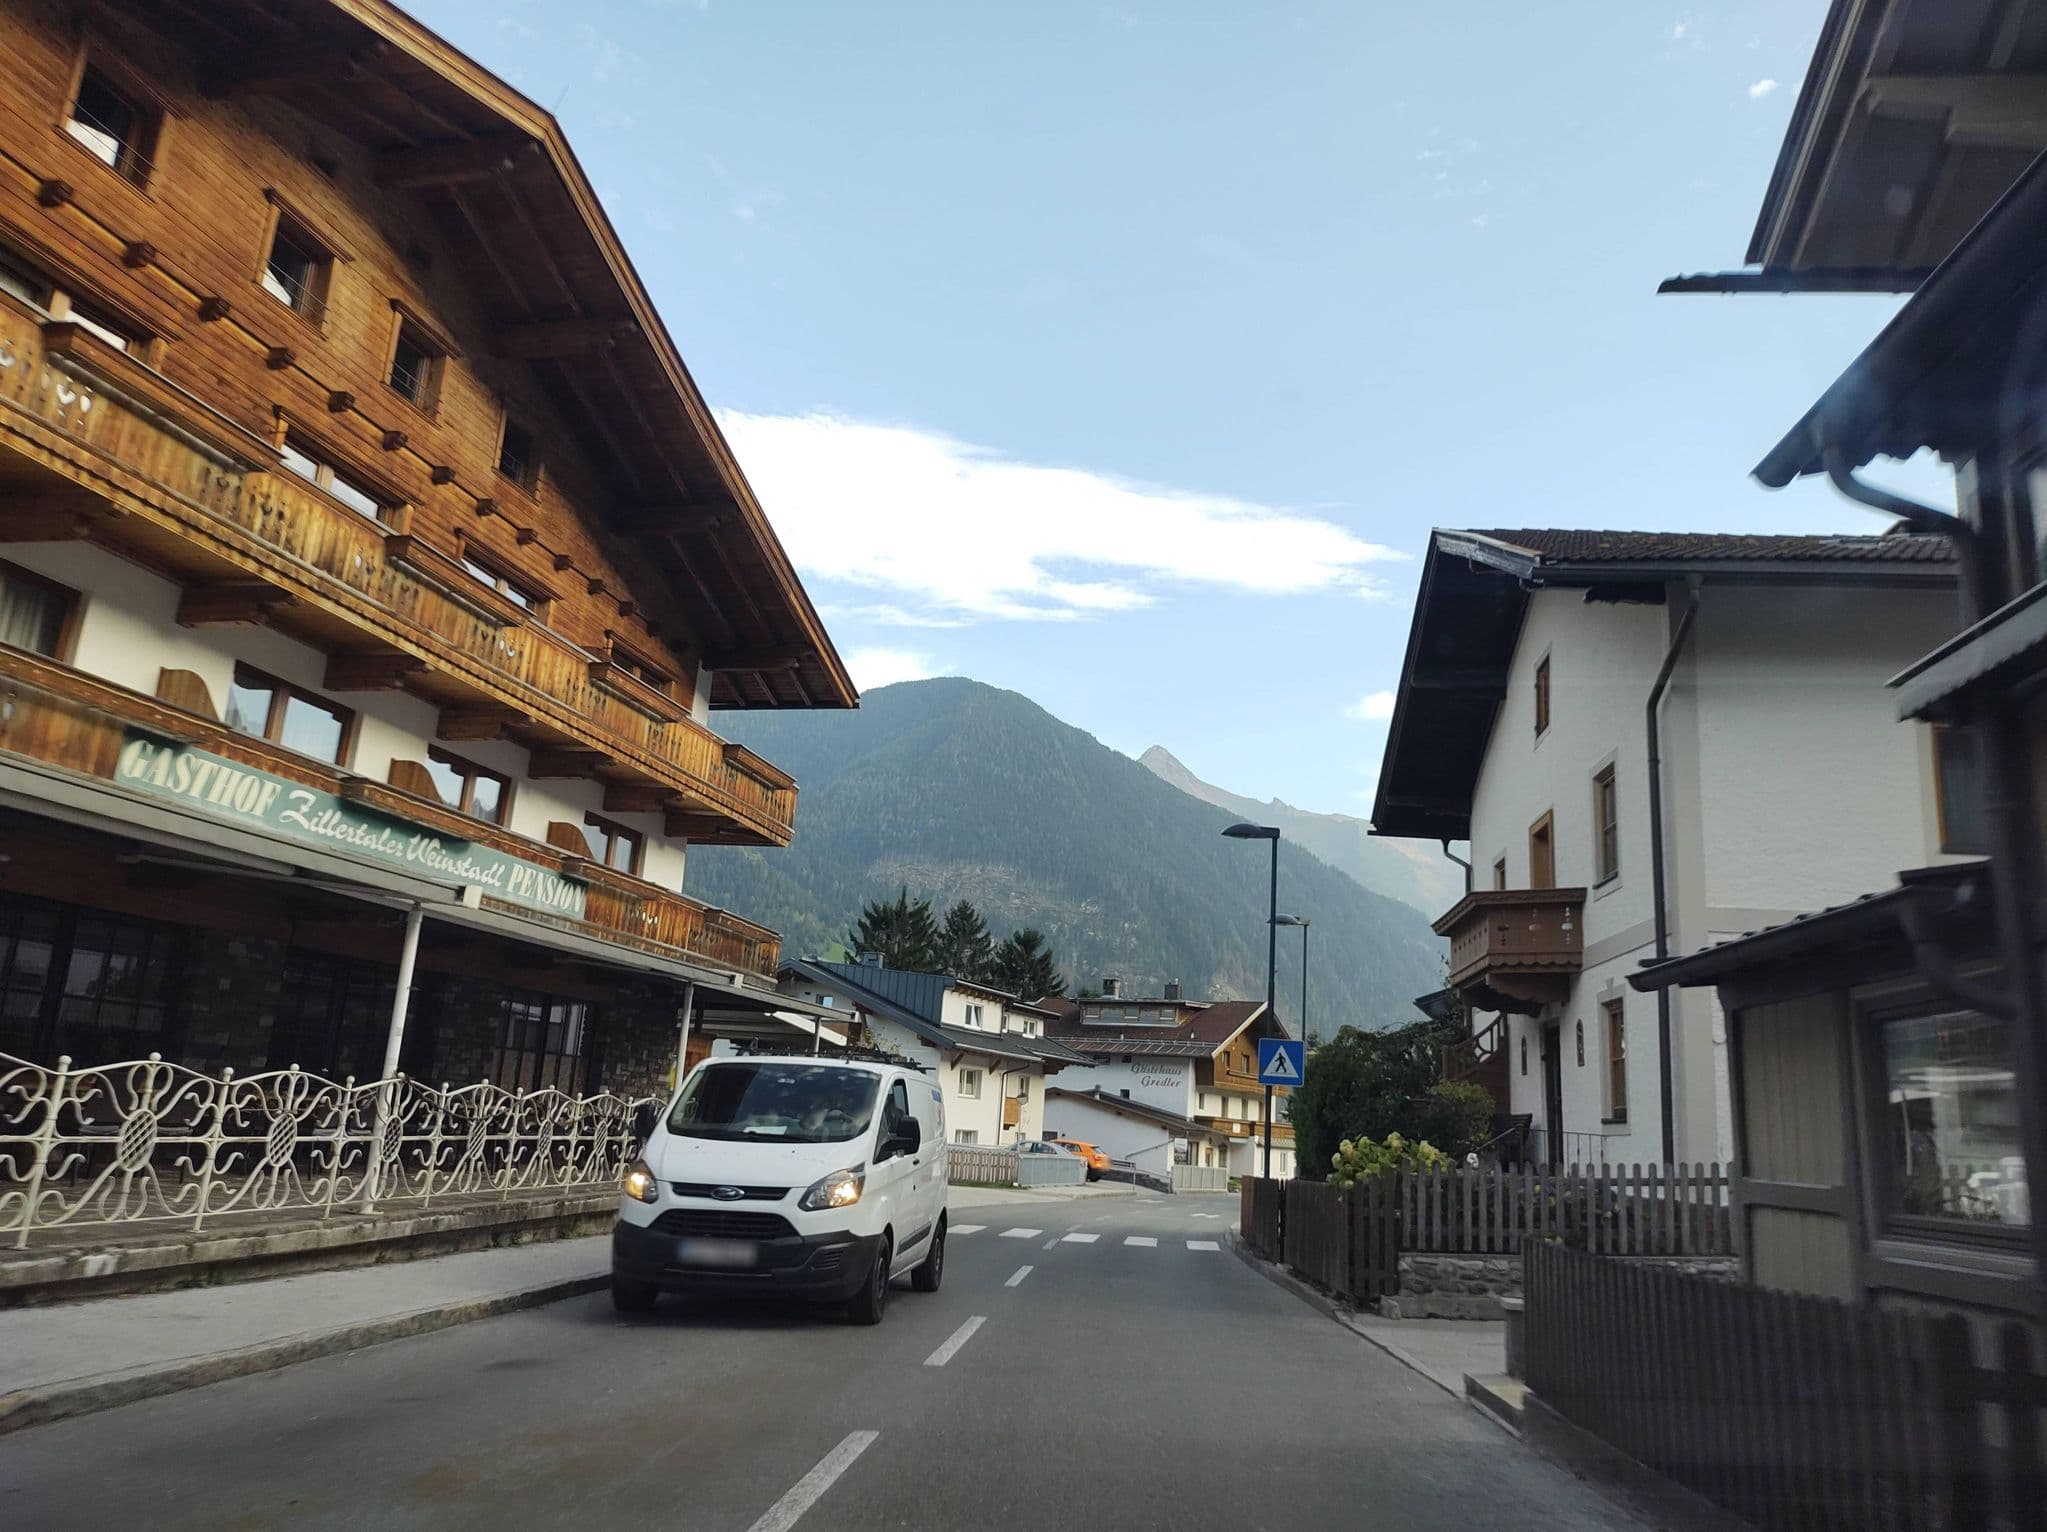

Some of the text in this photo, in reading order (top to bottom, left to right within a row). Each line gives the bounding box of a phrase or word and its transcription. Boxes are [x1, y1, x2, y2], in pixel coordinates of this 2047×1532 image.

[119, 739, 586, 914] GASTHOF Zillertaler Weinstadl PENSION
[1141, 1075, 1181, 1088] Gredler
